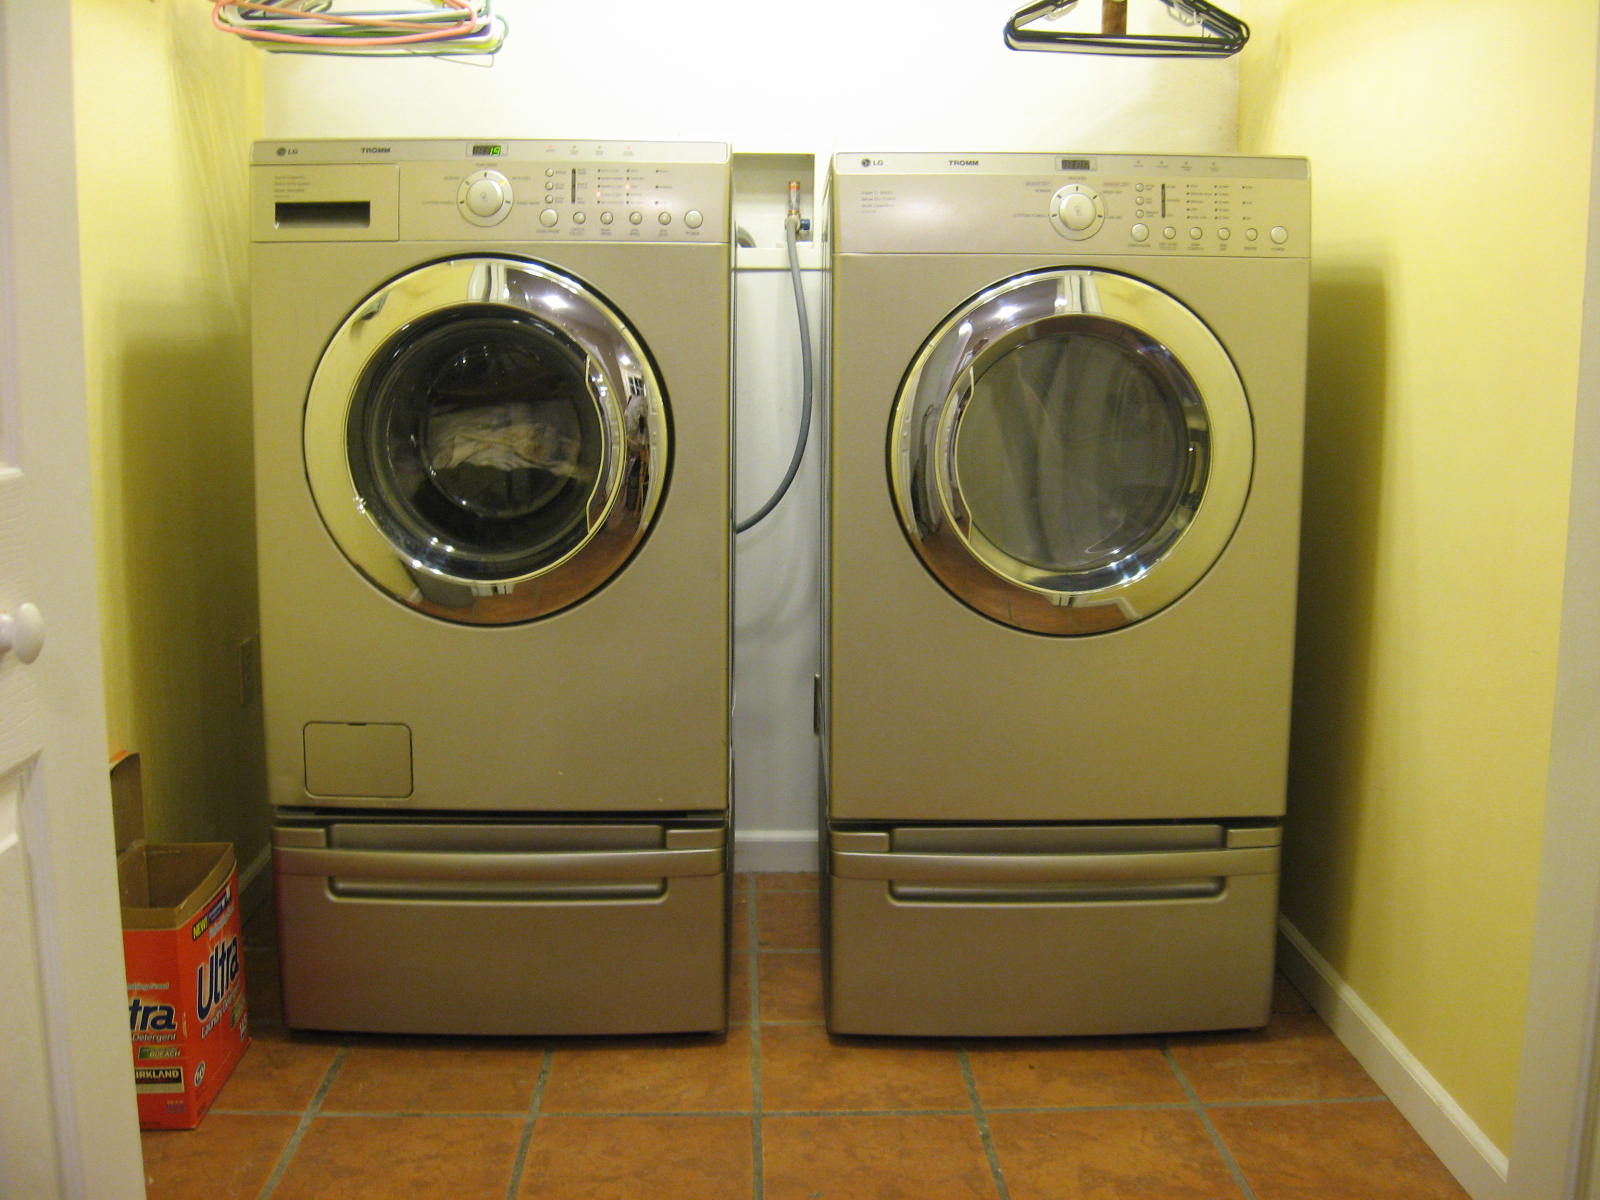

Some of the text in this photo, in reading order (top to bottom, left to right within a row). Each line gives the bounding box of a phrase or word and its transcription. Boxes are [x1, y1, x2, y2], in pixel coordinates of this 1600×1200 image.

[490, 146, 500, 157] 19
[197, 936, 239, 1021] Ultra
[129, 998, 176, 1031] tra
[135, 1070, 180, 1079] IRKLAND
